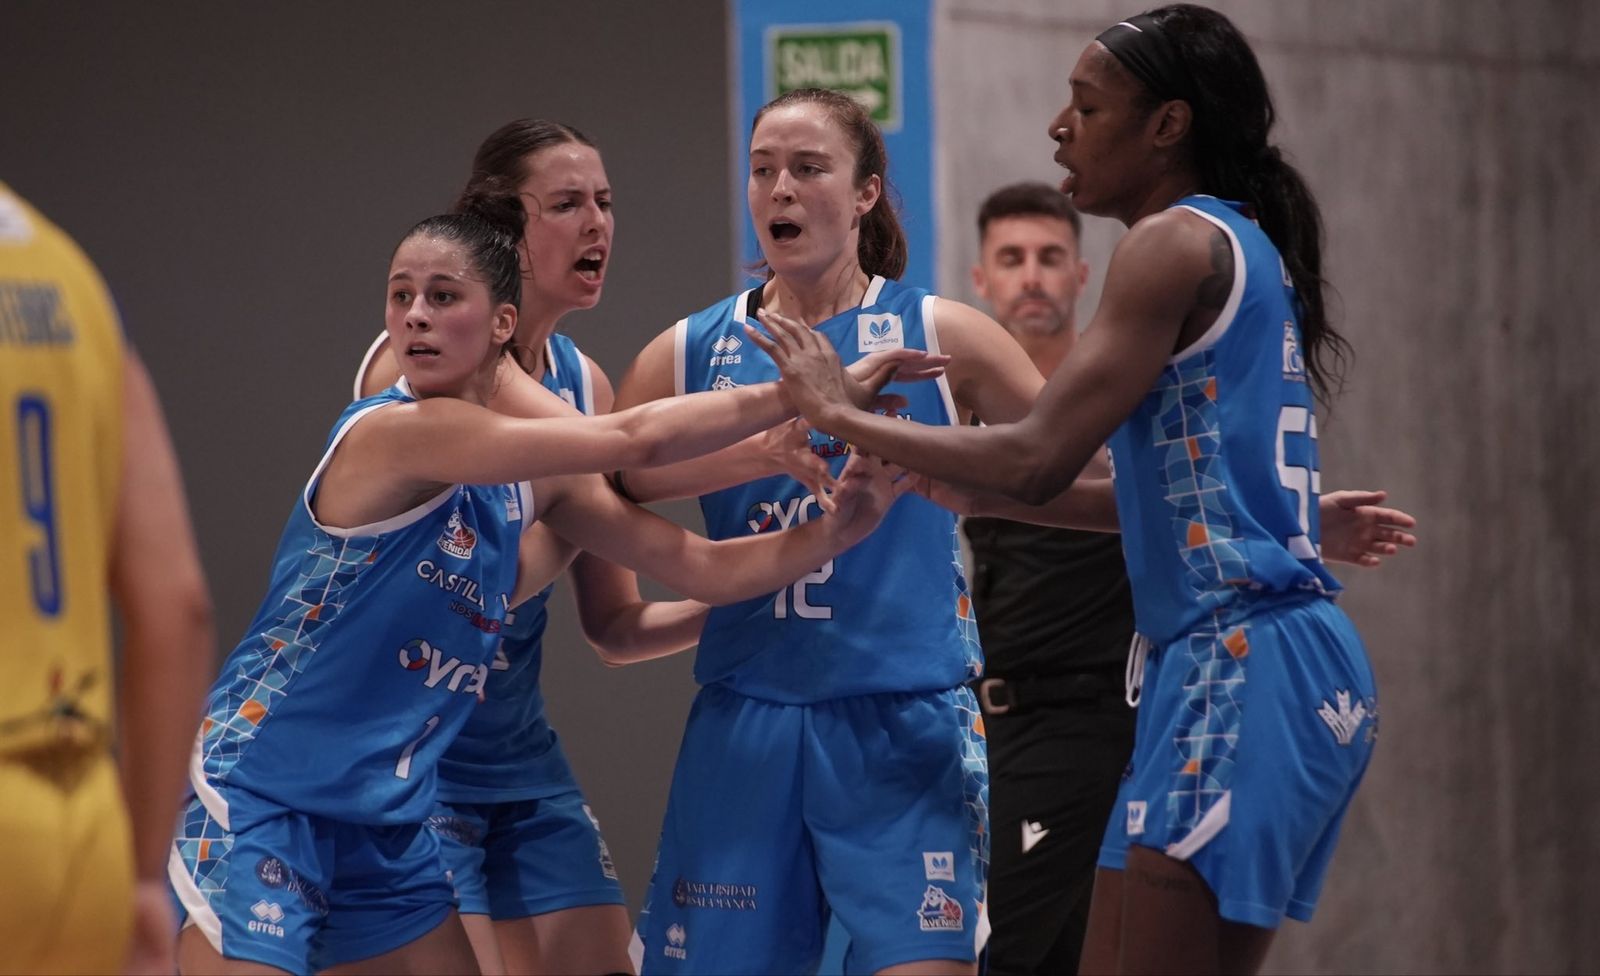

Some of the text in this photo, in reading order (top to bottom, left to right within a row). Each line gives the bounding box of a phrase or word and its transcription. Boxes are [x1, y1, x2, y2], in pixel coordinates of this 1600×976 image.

[782, 40, 885, 85] SALIDA
[710, 353, 742, 367] errea
[17, 391, 63, 619] 9
[1275, 405, 1322, 565] 5
[395, 716, 440, 779] 1
[248, 919, 284, 938] errea
